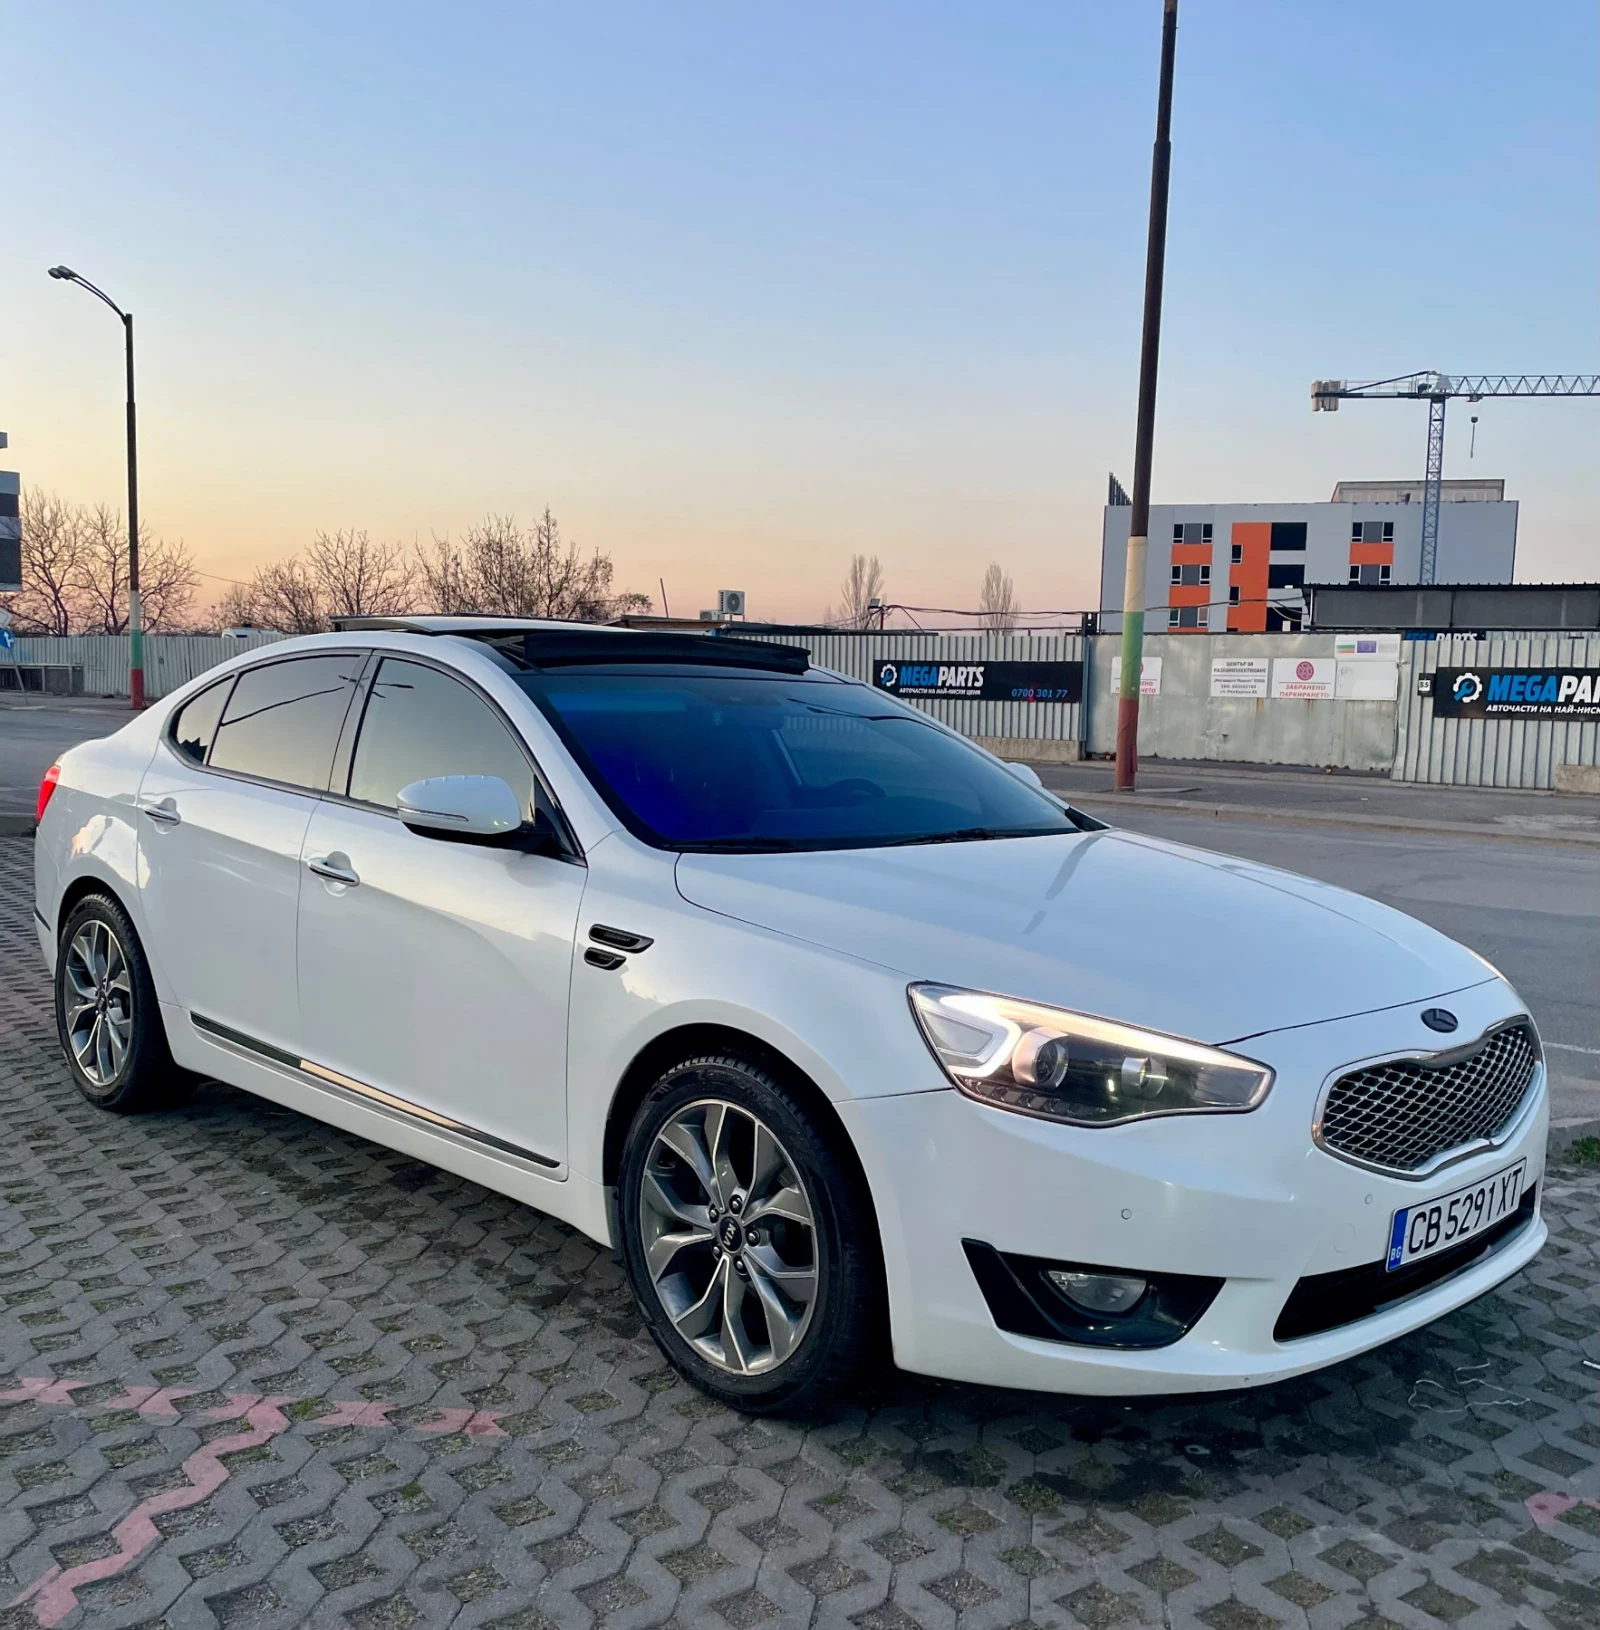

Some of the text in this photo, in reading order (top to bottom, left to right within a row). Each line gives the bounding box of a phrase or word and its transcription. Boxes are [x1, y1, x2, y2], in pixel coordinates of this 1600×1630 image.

[900, 665, 985, 687] MEGAPARTS
[936, 688, 966, 696] НАЙ-НИСКИ
[1011, 688, 1068, 698] 0700 301 77
[1486, 704, 1537, 713] АВТОЧАСТИ
[1539, 705, 1552, 713] НА
[1408, 1166, 1523, 1254] CB 5291 XT
[723, 1223, 737, 1246] KIA
[1390, 1246, 1402, 1261] BG
